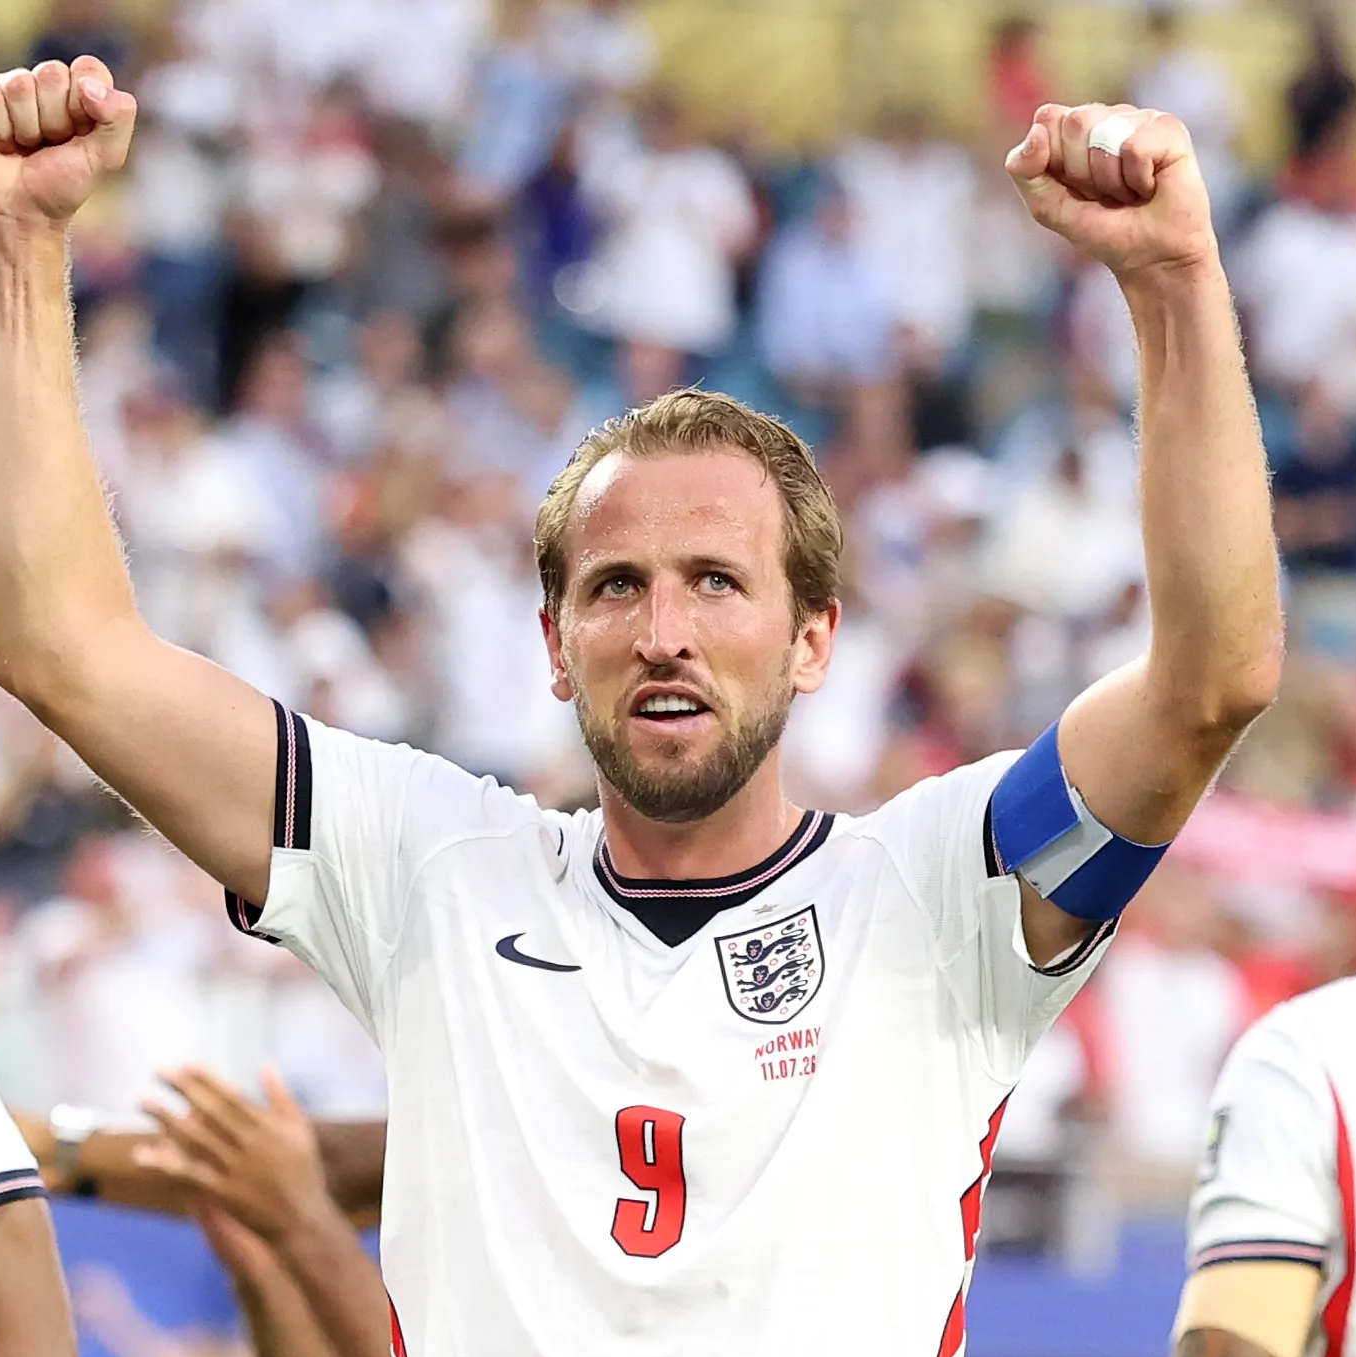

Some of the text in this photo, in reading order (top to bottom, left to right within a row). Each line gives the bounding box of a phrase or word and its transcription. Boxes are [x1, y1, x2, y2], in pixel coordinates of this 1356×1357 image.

[754, 1026, 821, 1060] NORWAY
[760, 1054, 817, 1081] 11.07.26
[611, 1104, 687, 1258] 9
